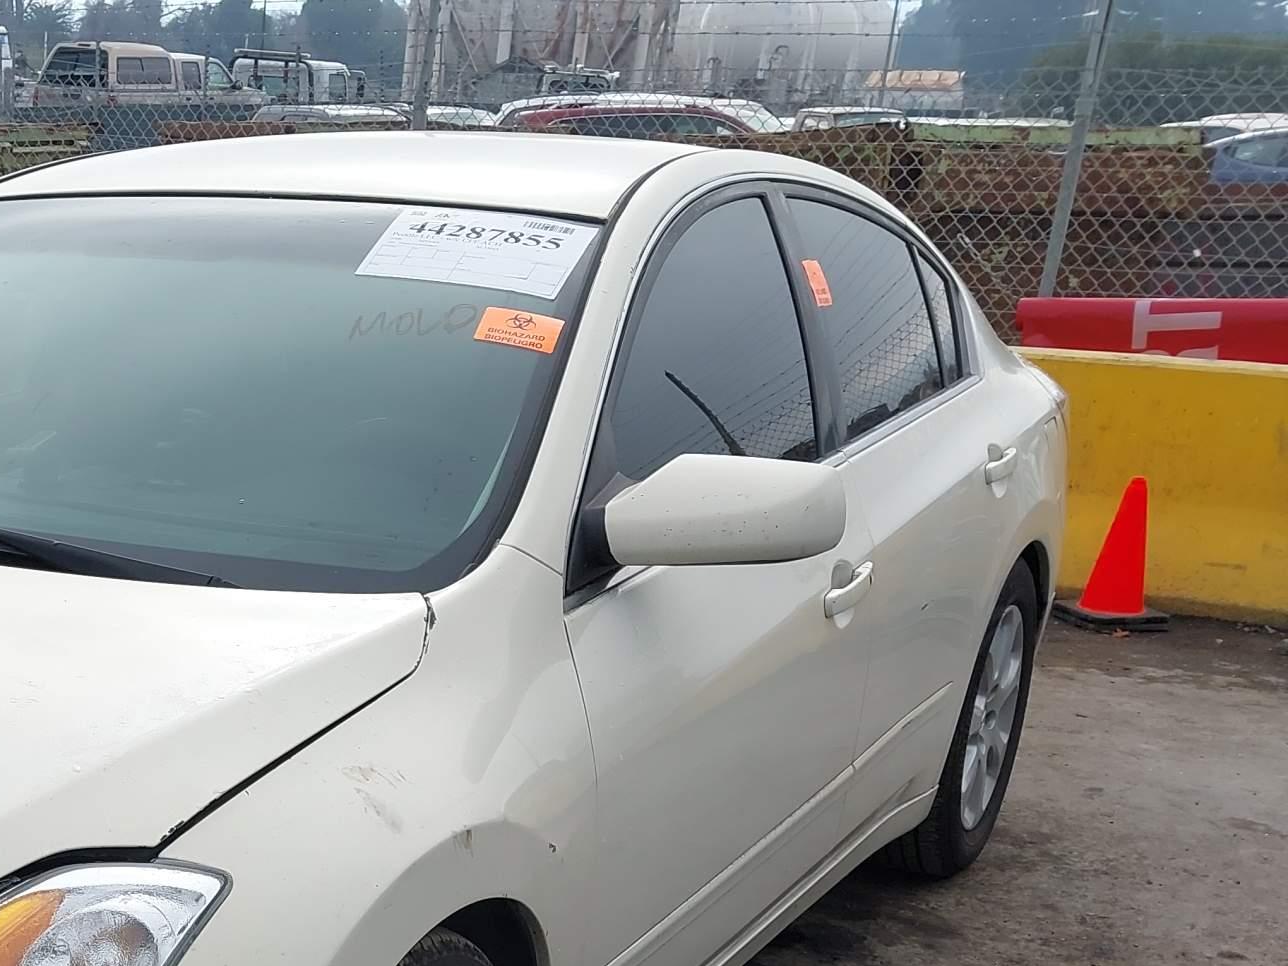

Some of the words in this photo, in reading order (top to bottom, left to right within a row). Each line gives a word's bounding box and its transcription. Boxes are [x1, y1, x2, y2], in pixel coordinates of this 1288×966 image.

[409, 221, 565, 250] 44287855
[483, 333, 543, 349] BIOPELIGRO
[487, 327, 546, 342] BIOHAZARD
